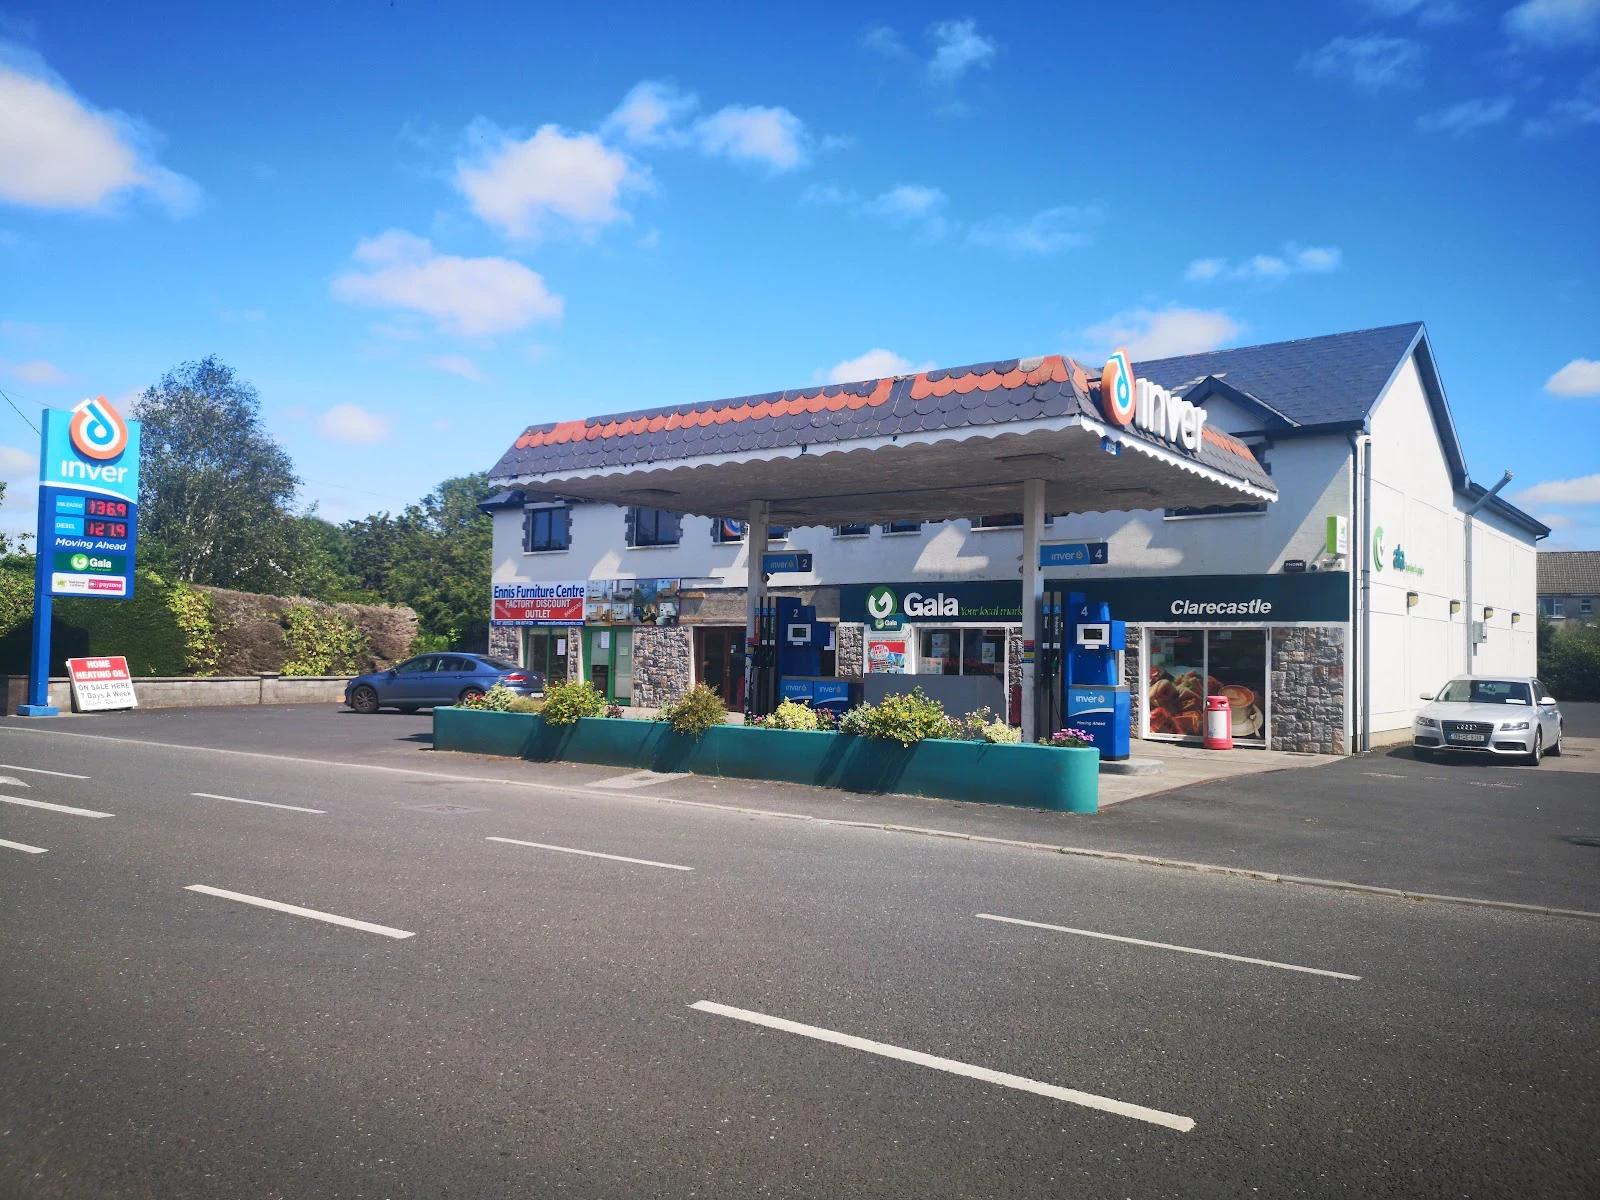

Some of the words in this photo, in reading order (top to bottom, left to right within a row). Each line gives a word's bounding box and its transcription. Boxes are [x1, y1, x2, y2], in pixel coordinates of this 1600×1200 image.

[1135, 377, 1208, 453] inver
[61, 460, 129, 483] inver
[57, 501, 83, 509] UNLEADED
[56, 522, 76, 530] DIESEL
[55, 538, 94, 549] Moving
[95, 541, 127, 551] Ahead
[1051, 552, 1075, 561] inver
[1095, 549, 1102, 560] 4
[89, 558, 112, 569] Gala
[771, 561, 788, 569] inver
[802, 559, 808, 568] 2
[494, 584, 515, 598] Ennis
[516, 584, 555, 598] Furniture
[556, 584, 585, 598] Centre
[505, 600, 535, 609] FACTORY
[536, 599, 571, 608] DISCOUNT
[903, 592, 959, 617] Gala
[960, 606, 977, 616] Your
[980, 605, 999, 616] local
[1170, 599, 1272, 615] Clarecastle
[525, 609, 551, 619] OUTLET
[793, 608, 799, 618] 2
[1080, 606, 1088, 617] 4
[884, 619, 898, 627] Gala
[86, 660, 112, 669] HOME
[76, 670, 112, 680] HEATING
[112, 669, 127, 678] OIL
[91, 683, 110, 691] SALE
[110, 682, 131, 690] HERE
[785, 684, 802, 692] inver
[87, 692, 105, 700] Days
[112, 690, 132, 698] Week
[1075, 695, 1098, 703] inver
